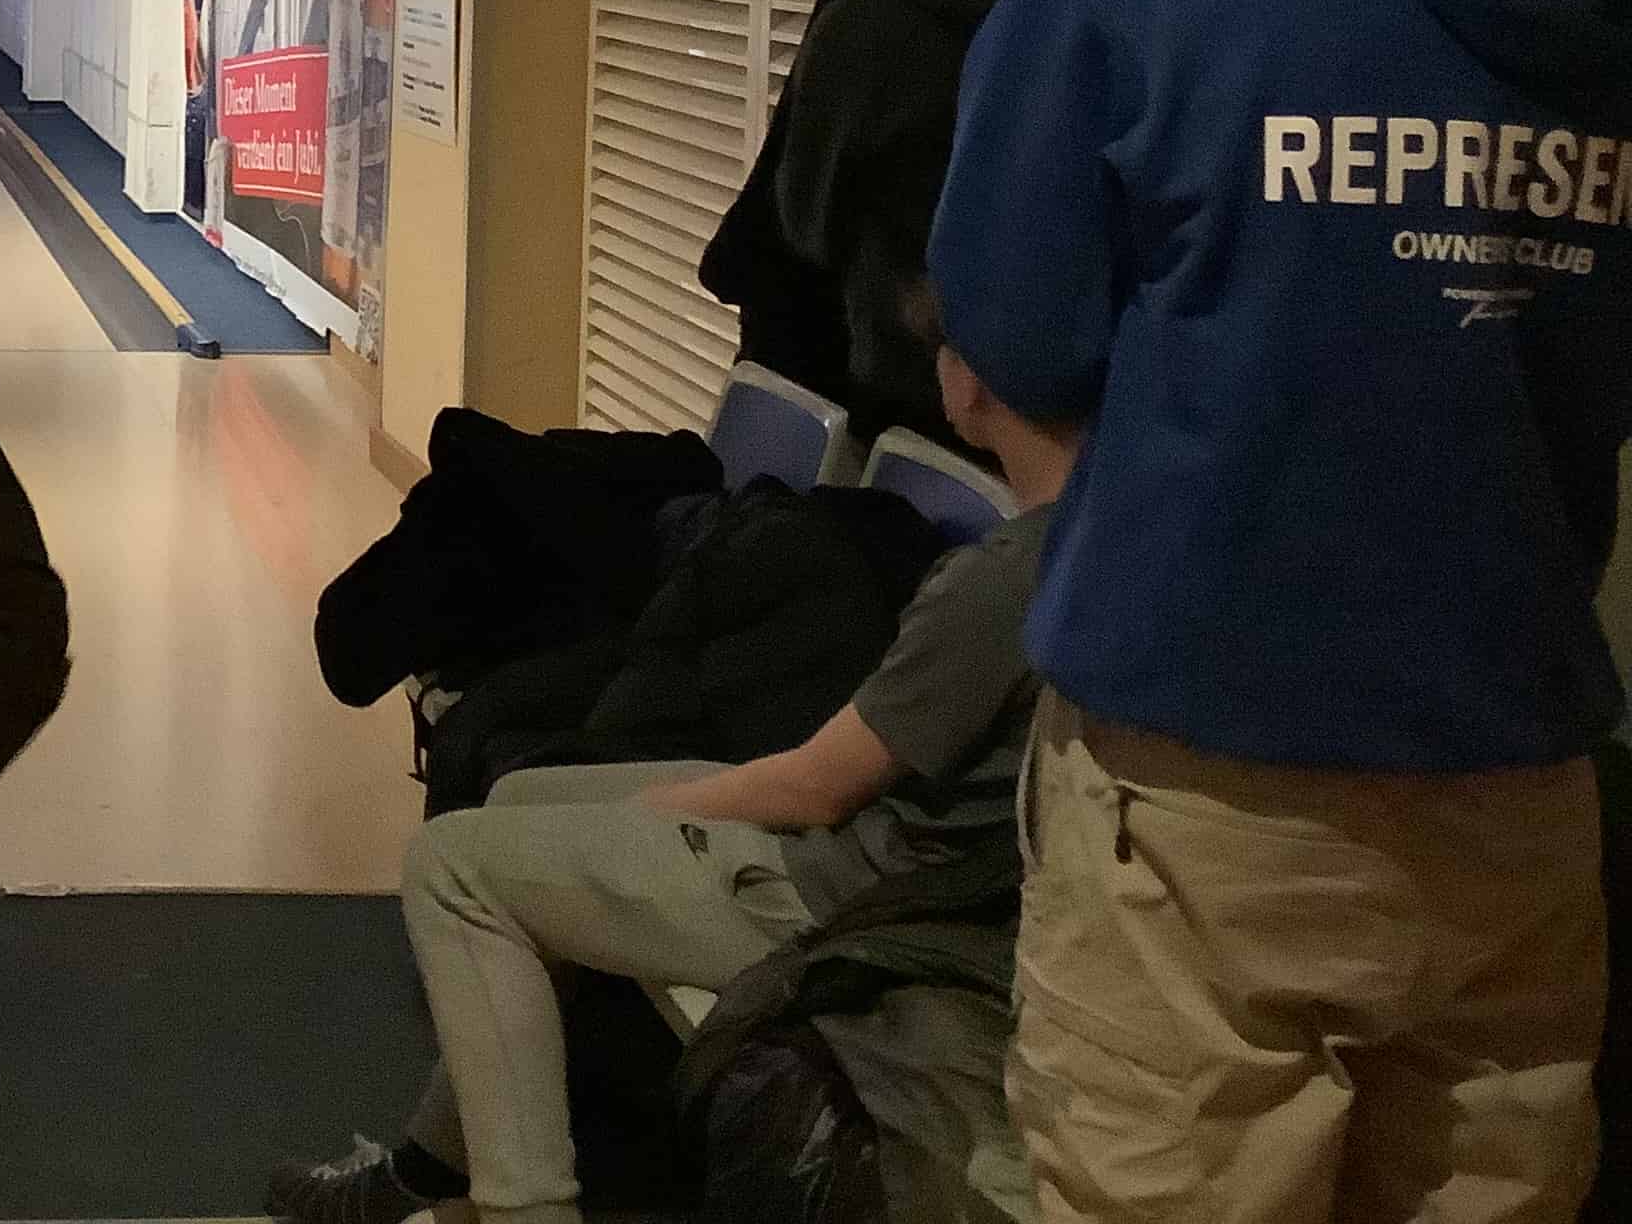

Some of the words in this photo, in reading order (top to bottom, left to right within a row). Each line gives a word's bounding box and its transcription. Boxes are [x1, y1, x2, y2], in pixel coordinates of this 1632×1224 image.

[224, 76, 254, 116] Dieser
[254, 72, 297, 114] Moment
[235, 128, 275, 171] verdient
[276, 128, 293, 172] ein
[1514, 236, 1596, 275] CLUB
